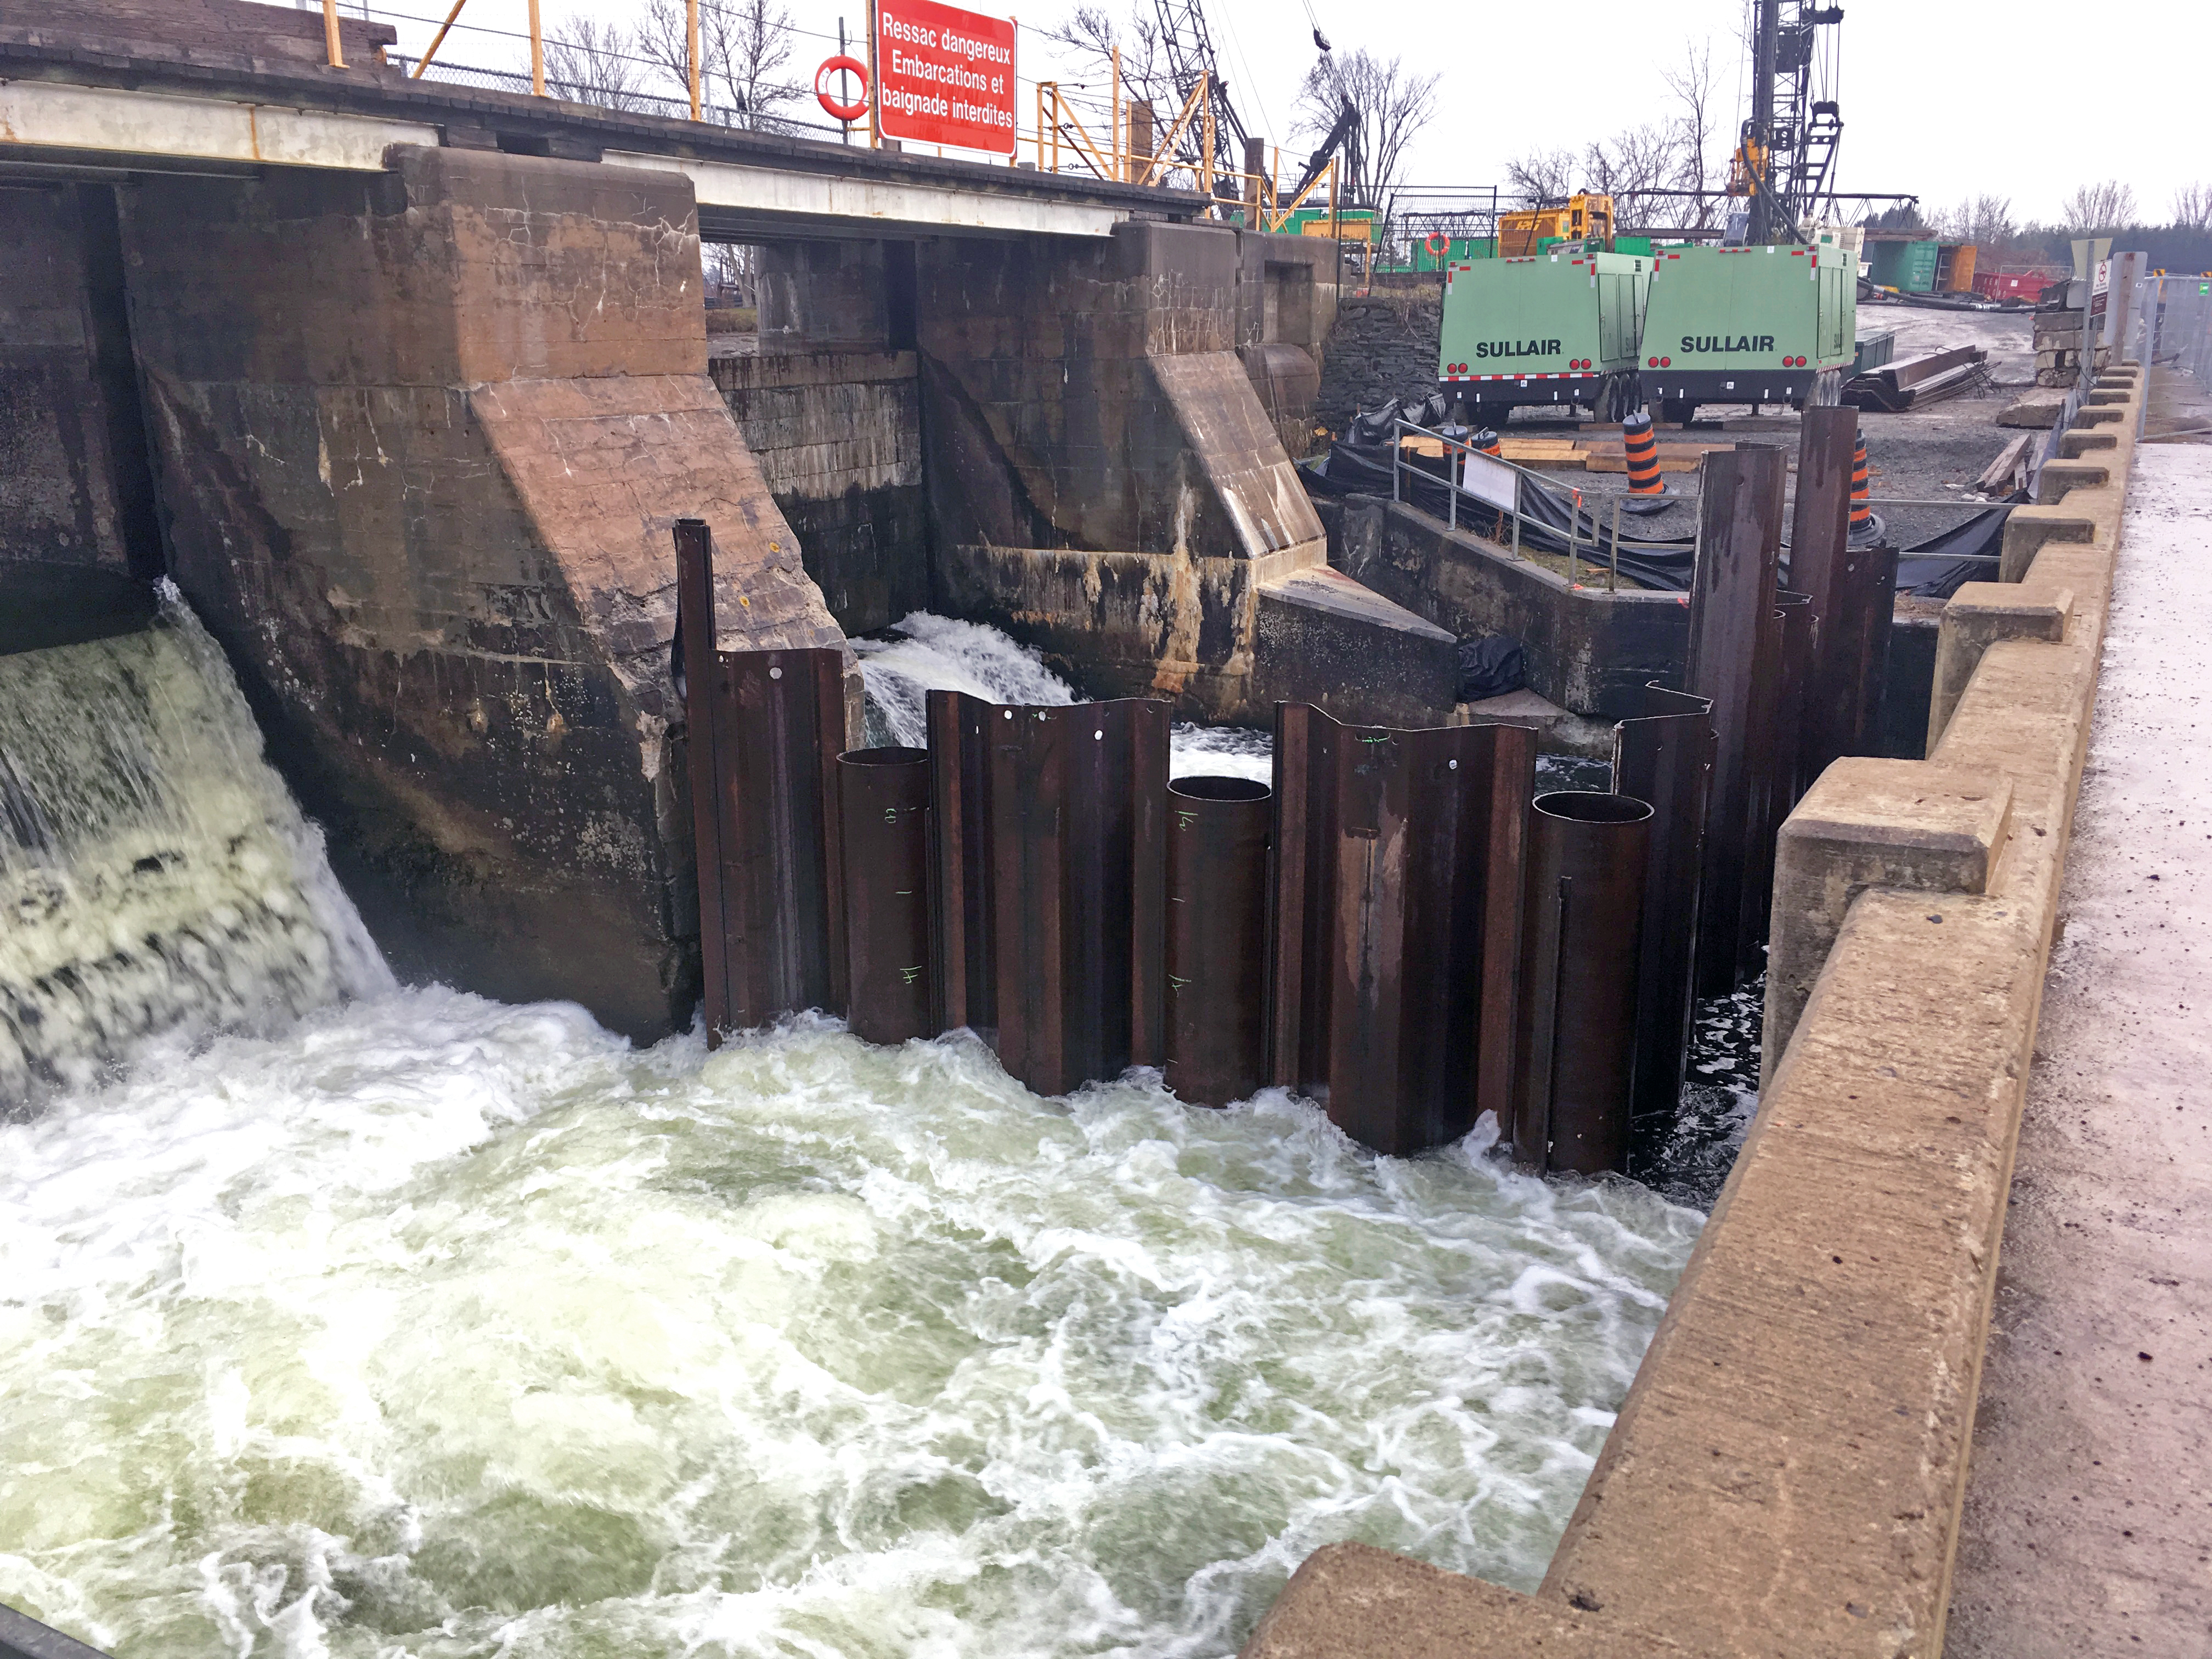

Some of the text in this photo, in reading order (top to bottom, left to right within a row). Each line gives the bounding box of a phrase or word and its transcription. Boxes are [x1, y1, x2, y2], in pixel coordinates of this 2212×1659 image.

[883, 12, 1011, 65] Ressac dangereux
[892, 49, 1004, 94] Embarcations et
[882, 82, 1013, 128] baignade interdites
[1476, 339, 1561, 358] SULLAIR
[1680, 335, 1775, 353] SULLAIR
